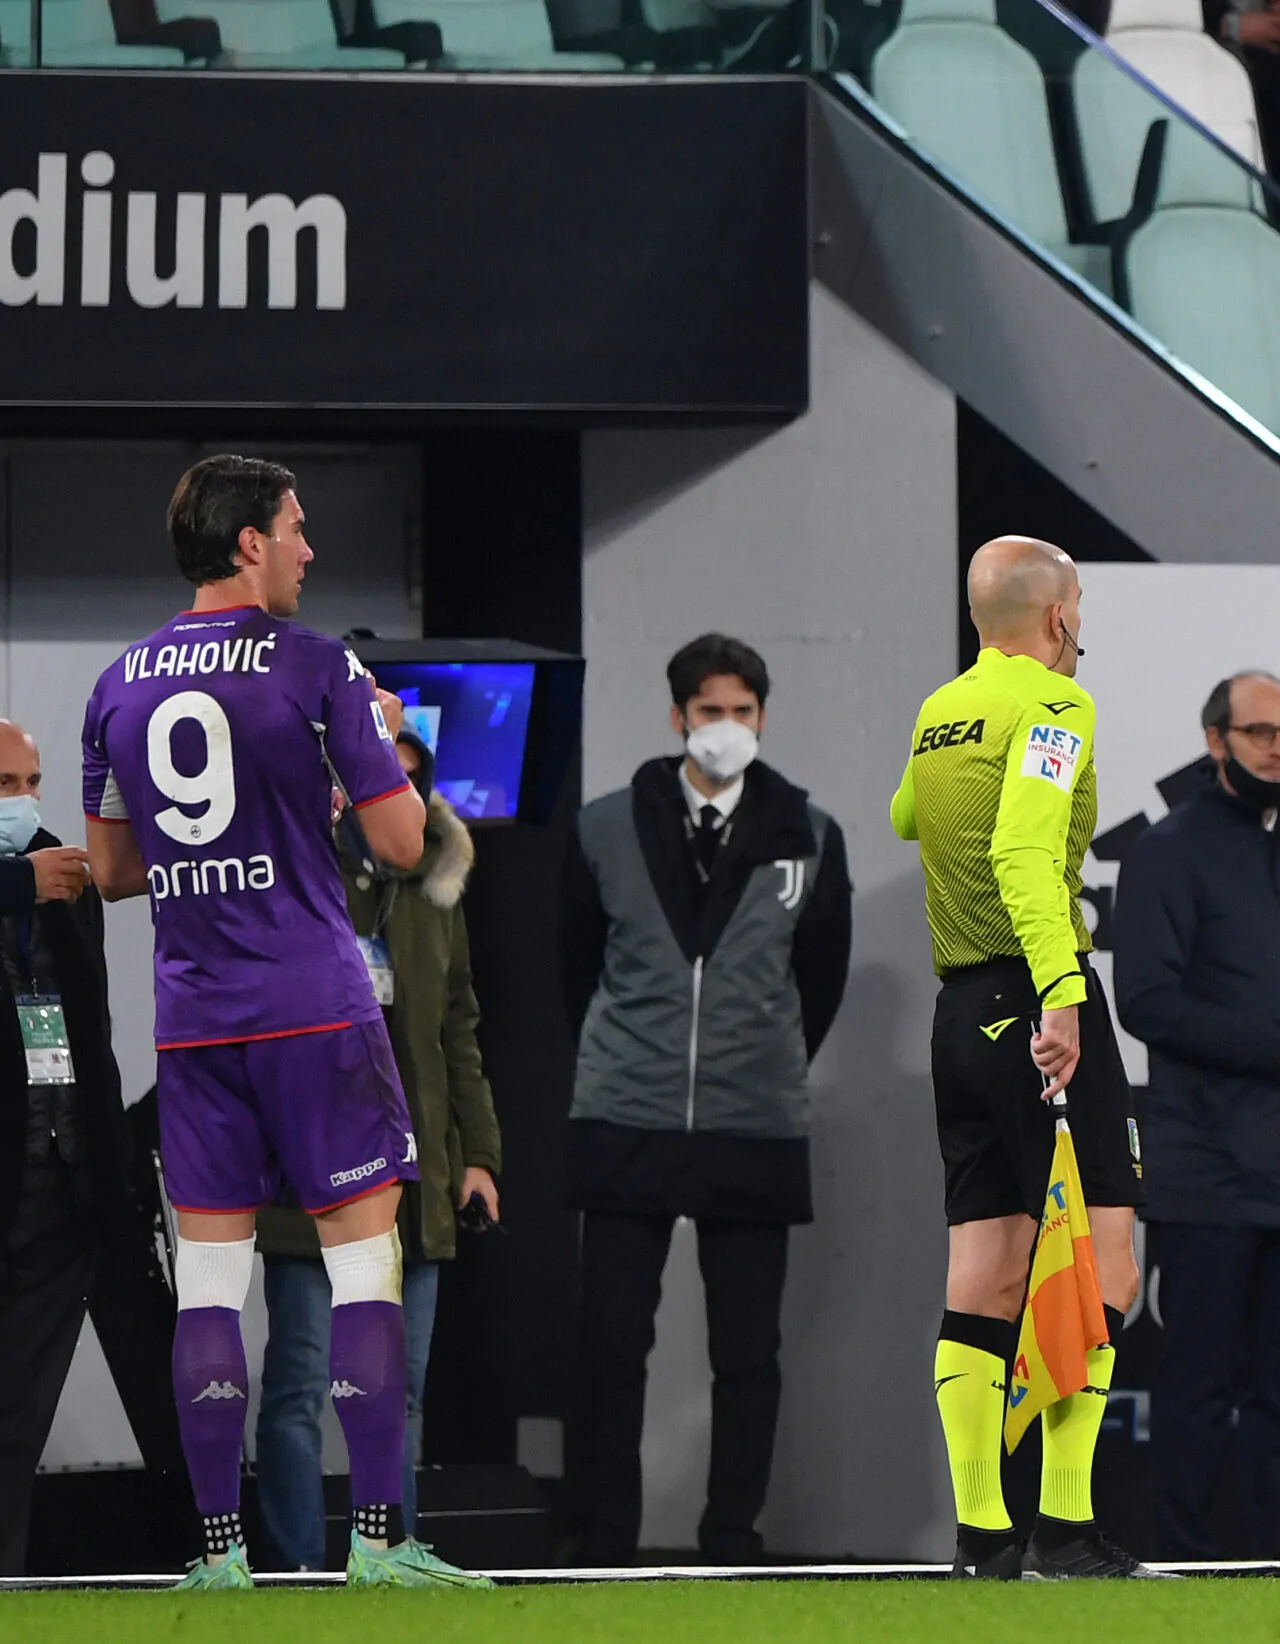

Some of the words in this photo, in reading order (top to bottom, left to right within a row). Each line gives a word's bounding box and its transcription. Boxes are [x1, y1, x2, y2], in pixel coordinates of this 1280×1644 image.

[0, 150, 347, 310] dium
[124, 632, 277, 684] VLAHOVIĆ
[913, 718, 986, 757] EGEA
[1030, 726, 1081, 756] NET
[147, 690, 236, 846] 9
[147, 854, 275, 913] prima
[329, 1157, 387, 1187] Kappa
